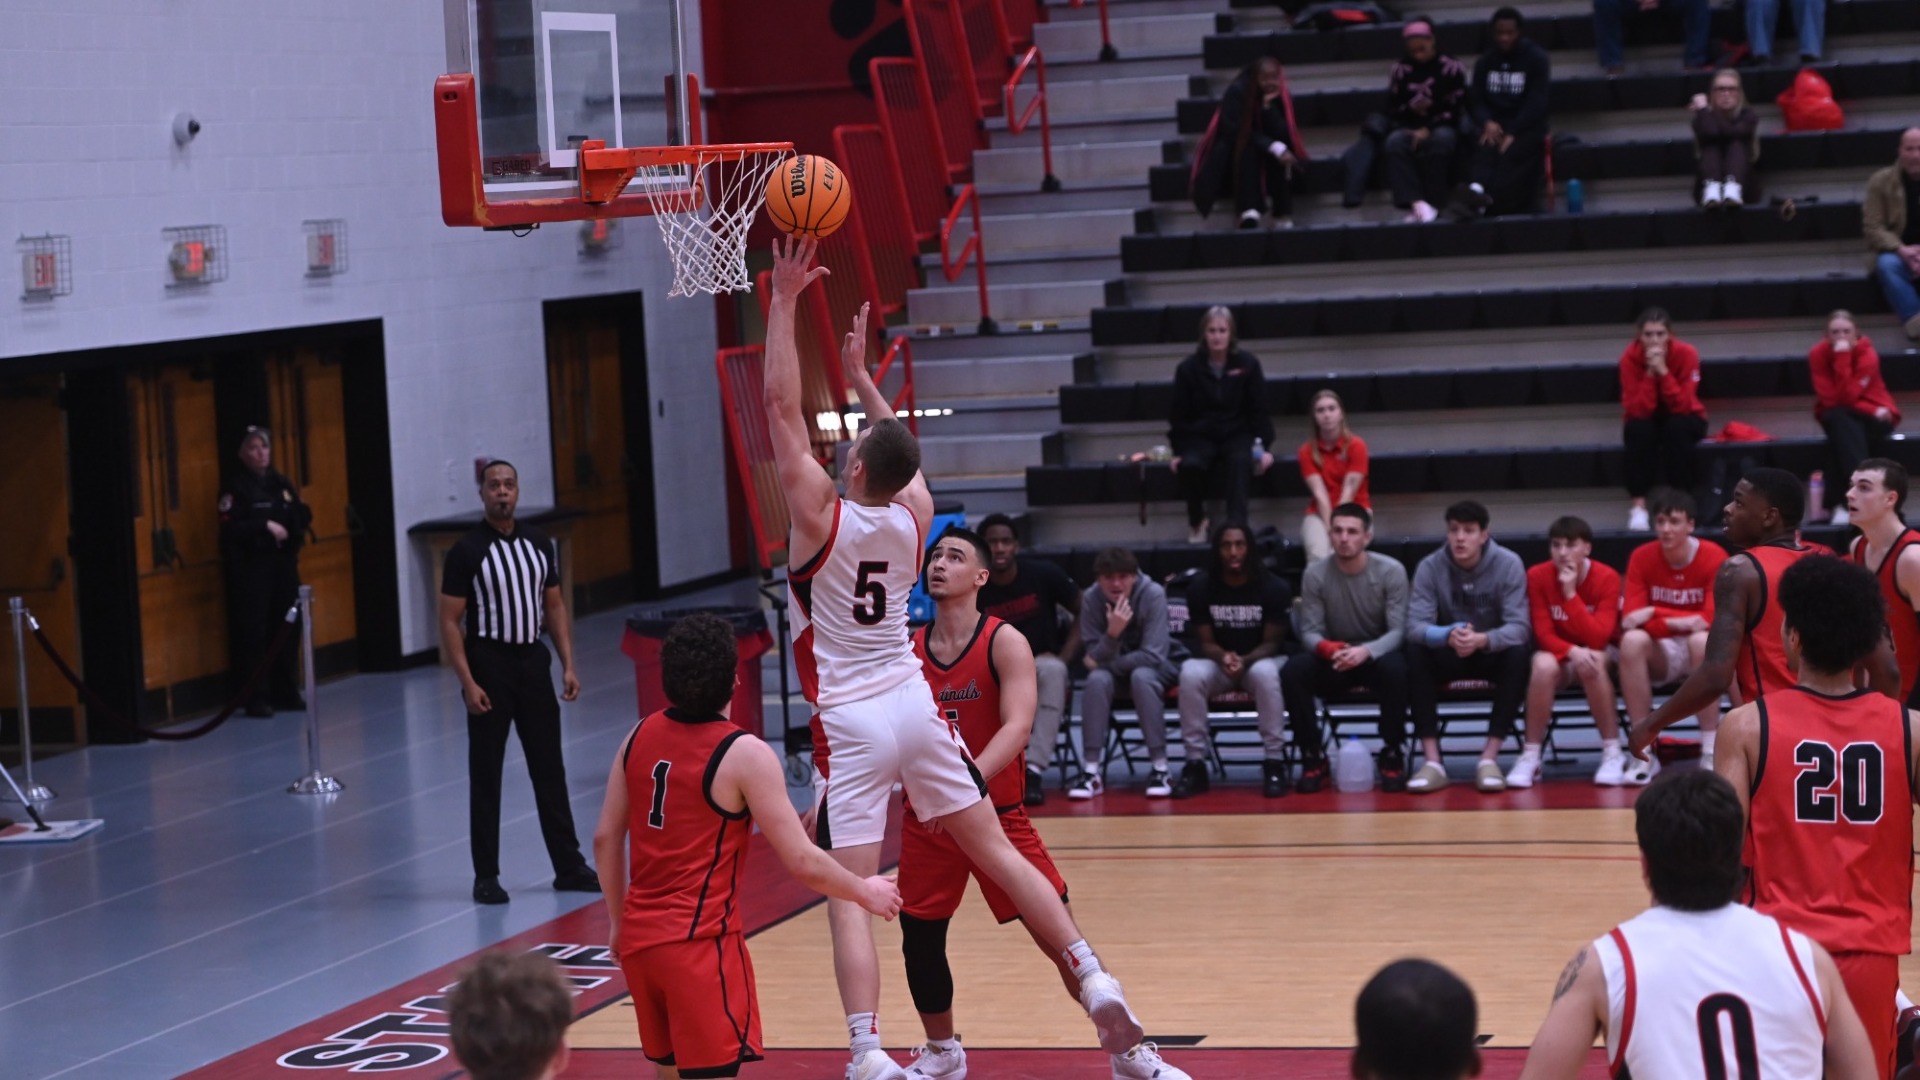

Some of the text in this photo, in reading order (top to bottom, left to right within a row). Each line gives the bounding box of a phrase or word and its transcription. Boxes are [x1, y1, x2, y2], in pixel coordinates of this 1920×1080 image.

[852, 561, 889, 626] 5
[1651, 586, 1704, 605] BOBCATS
[938, 679, 982, 702] dinals
[648, 760, 672, 829] 1
[1793, 741, 1884, 825] 20
[1697, 992, 1761, 1080] 0
